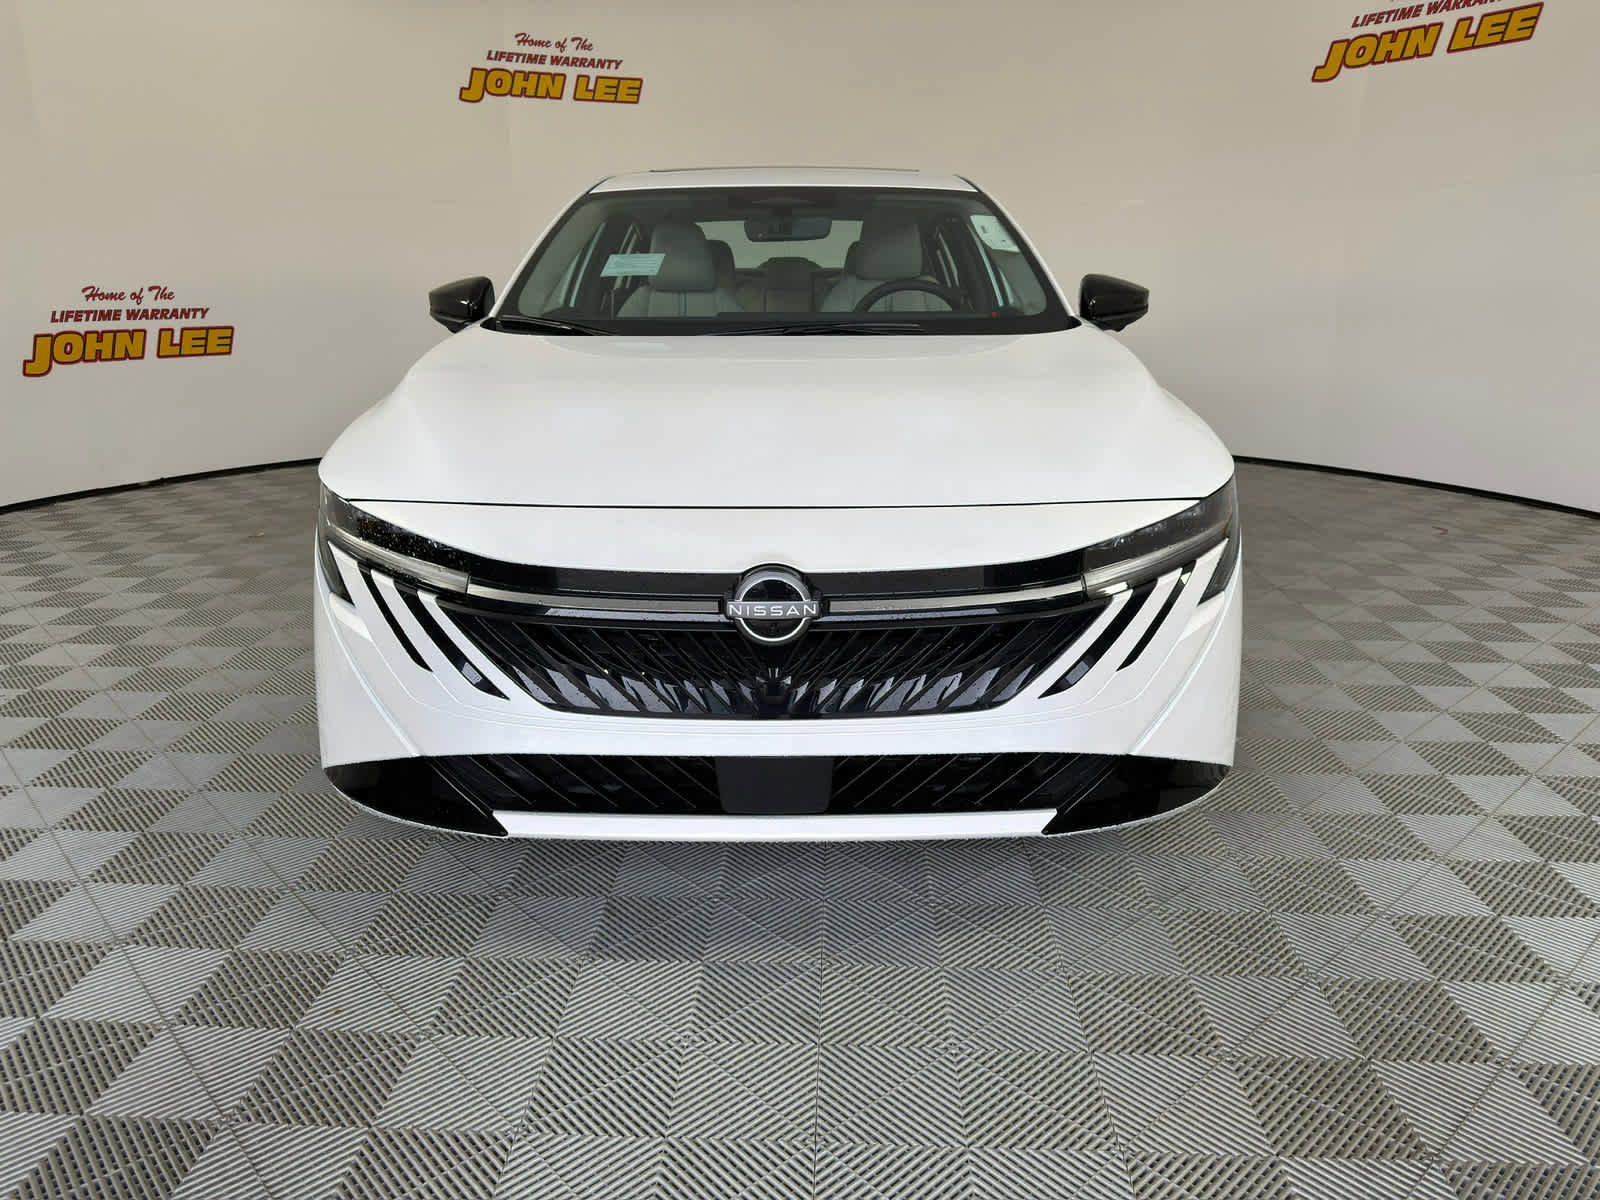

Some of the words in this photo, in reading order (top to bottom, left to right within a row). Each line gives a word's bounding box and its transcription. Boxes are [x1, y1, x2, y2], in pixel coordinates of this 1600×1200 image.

[1351, 4, 1424, 28] LIFETIME
[515, 33, 552, 47] Home
[555, 38, 567, 52] of
[571, 37, 593, 51] The
[1311, 22, 1444, 83] JOHN
[1447, 2, 1544, 53] LEE
[487, 50, 547, 64] LIFETIME
[550, 55, 623, 70] WARRANTY
[459, 67, 566, 103] JOHN
[573, 74, 643, 104] LEE
[82, 286, 126, 301] Home
[130, 288, 143, 305] of
[149, 286, 175, 300] The
[51, 309, 122, 323] LIFETIME
[126, 308, 209, 320] WARRANTY
[23, 329, 147, 377] JOHN
[156, 326, 234, 358] LEE
[729, 604, 817, 616] NISSAN
